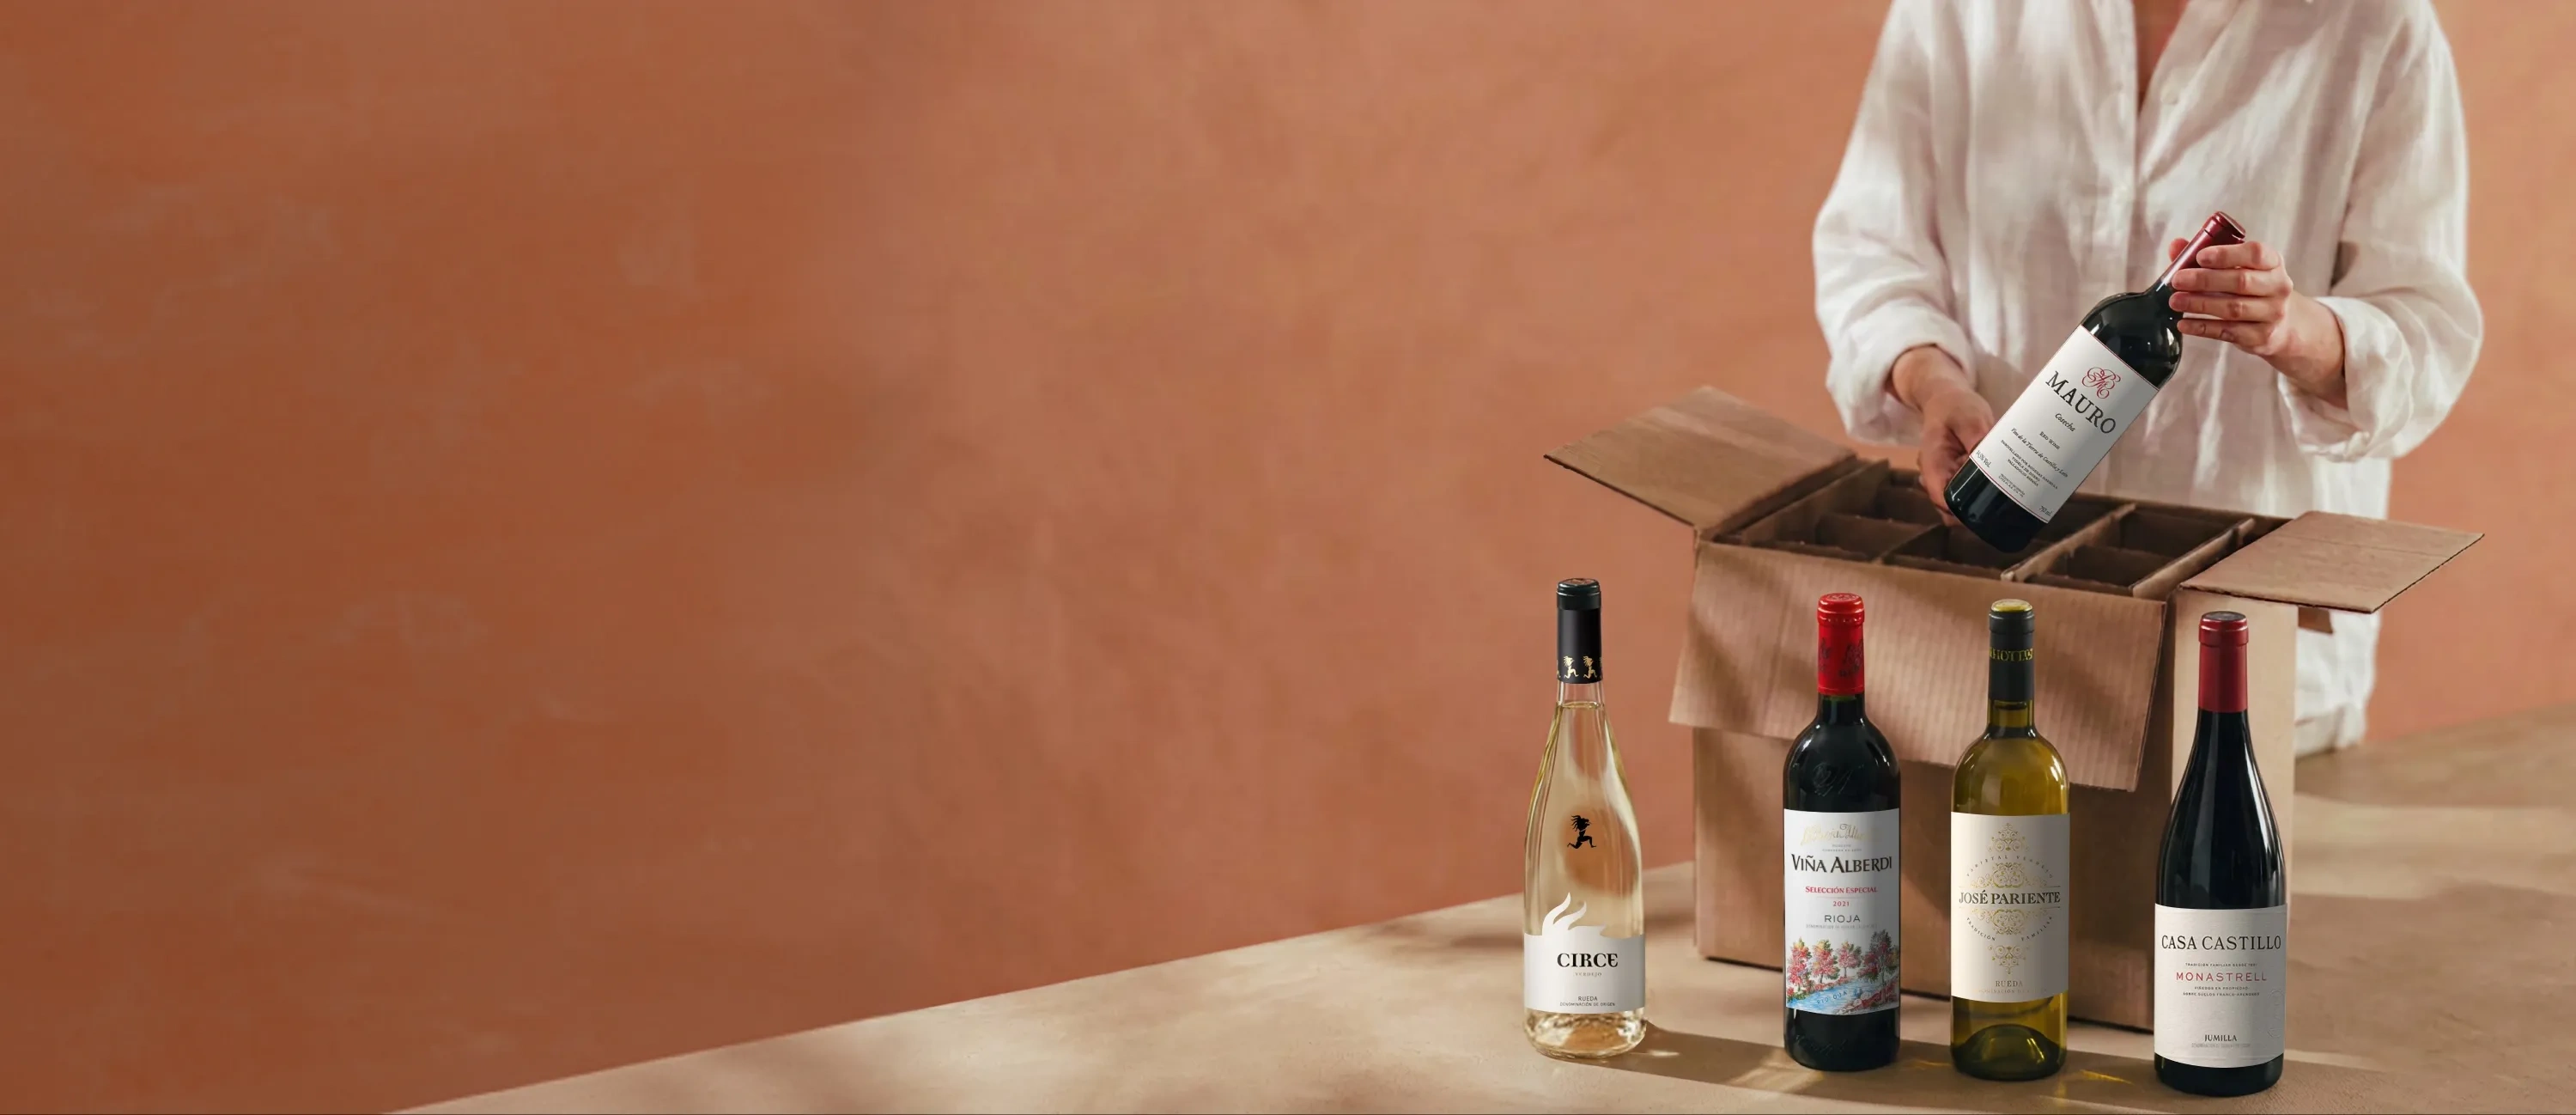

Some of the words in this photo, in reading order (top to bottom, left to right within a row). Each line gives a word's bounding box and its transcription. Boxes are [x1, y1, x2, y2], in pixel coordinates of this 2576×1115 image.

[2045, 370, 2117, 435] MAURO
[2055, 413, 2076, 432] Cosecha
[2039, 431, 2050, 441] RED
[1791, 854, 1827, 873] VIÑA
[1830, 856, 1893, 874] ALBERDI
[1805, 886, 1844, 894] SELECCIÓN
[1959, 890, 1988, 905] JOSÉ
[1991, 891, 2061, 905] PARIENTE
[1824, 915, 1861, 923] RIOJA
[2161, 935, 2197, 950] CASA
[2202, 935, 2281, 950] CASTILLO
[1557, 953, 1619, 968] CIRCE
[2176, 972, 2267, 982] MONASTRELL
